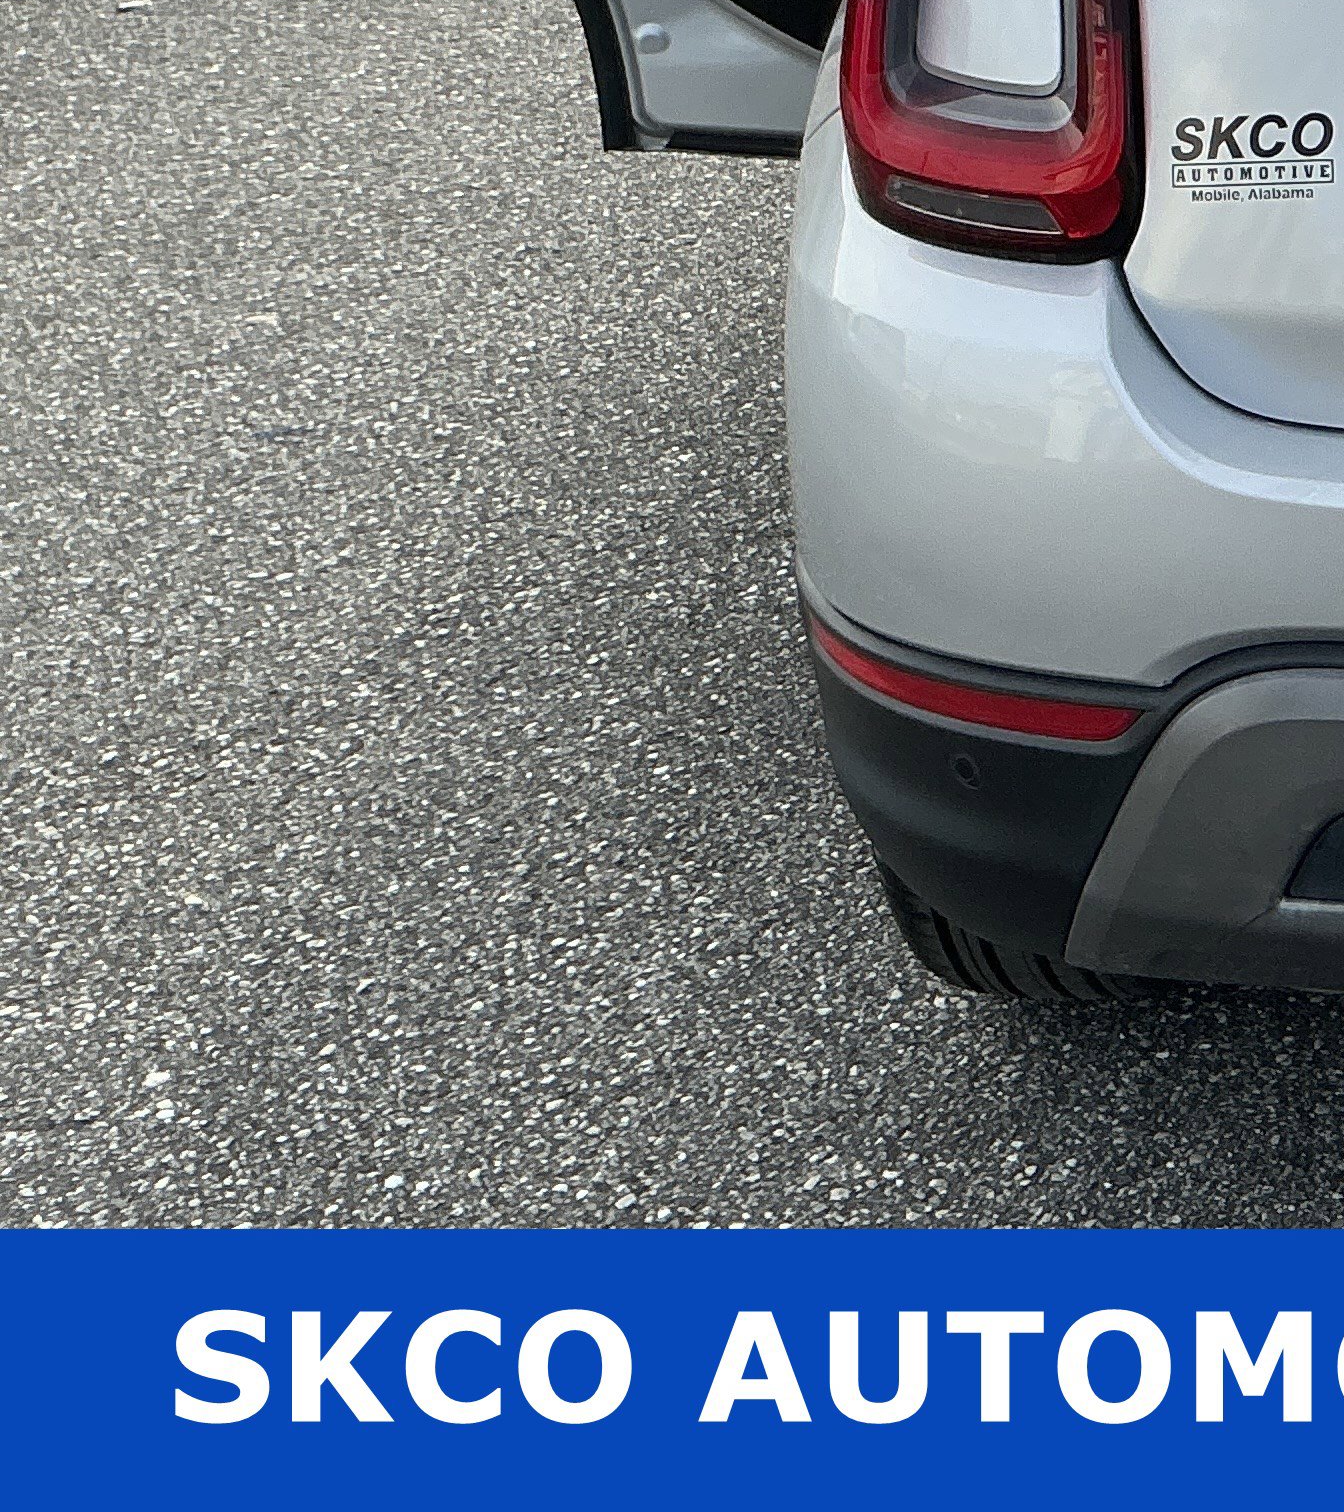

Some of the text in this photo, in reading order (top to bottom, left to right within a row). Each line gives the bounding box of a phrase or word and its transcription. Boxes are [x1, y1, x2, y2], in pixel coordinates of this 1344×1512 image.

[1171, 112, 1334, 161] SKCO
[1175, 164, 1331, 183] AUTOMOTIVE
[1191, 188, 1314, 203] Mobile, Alabama
